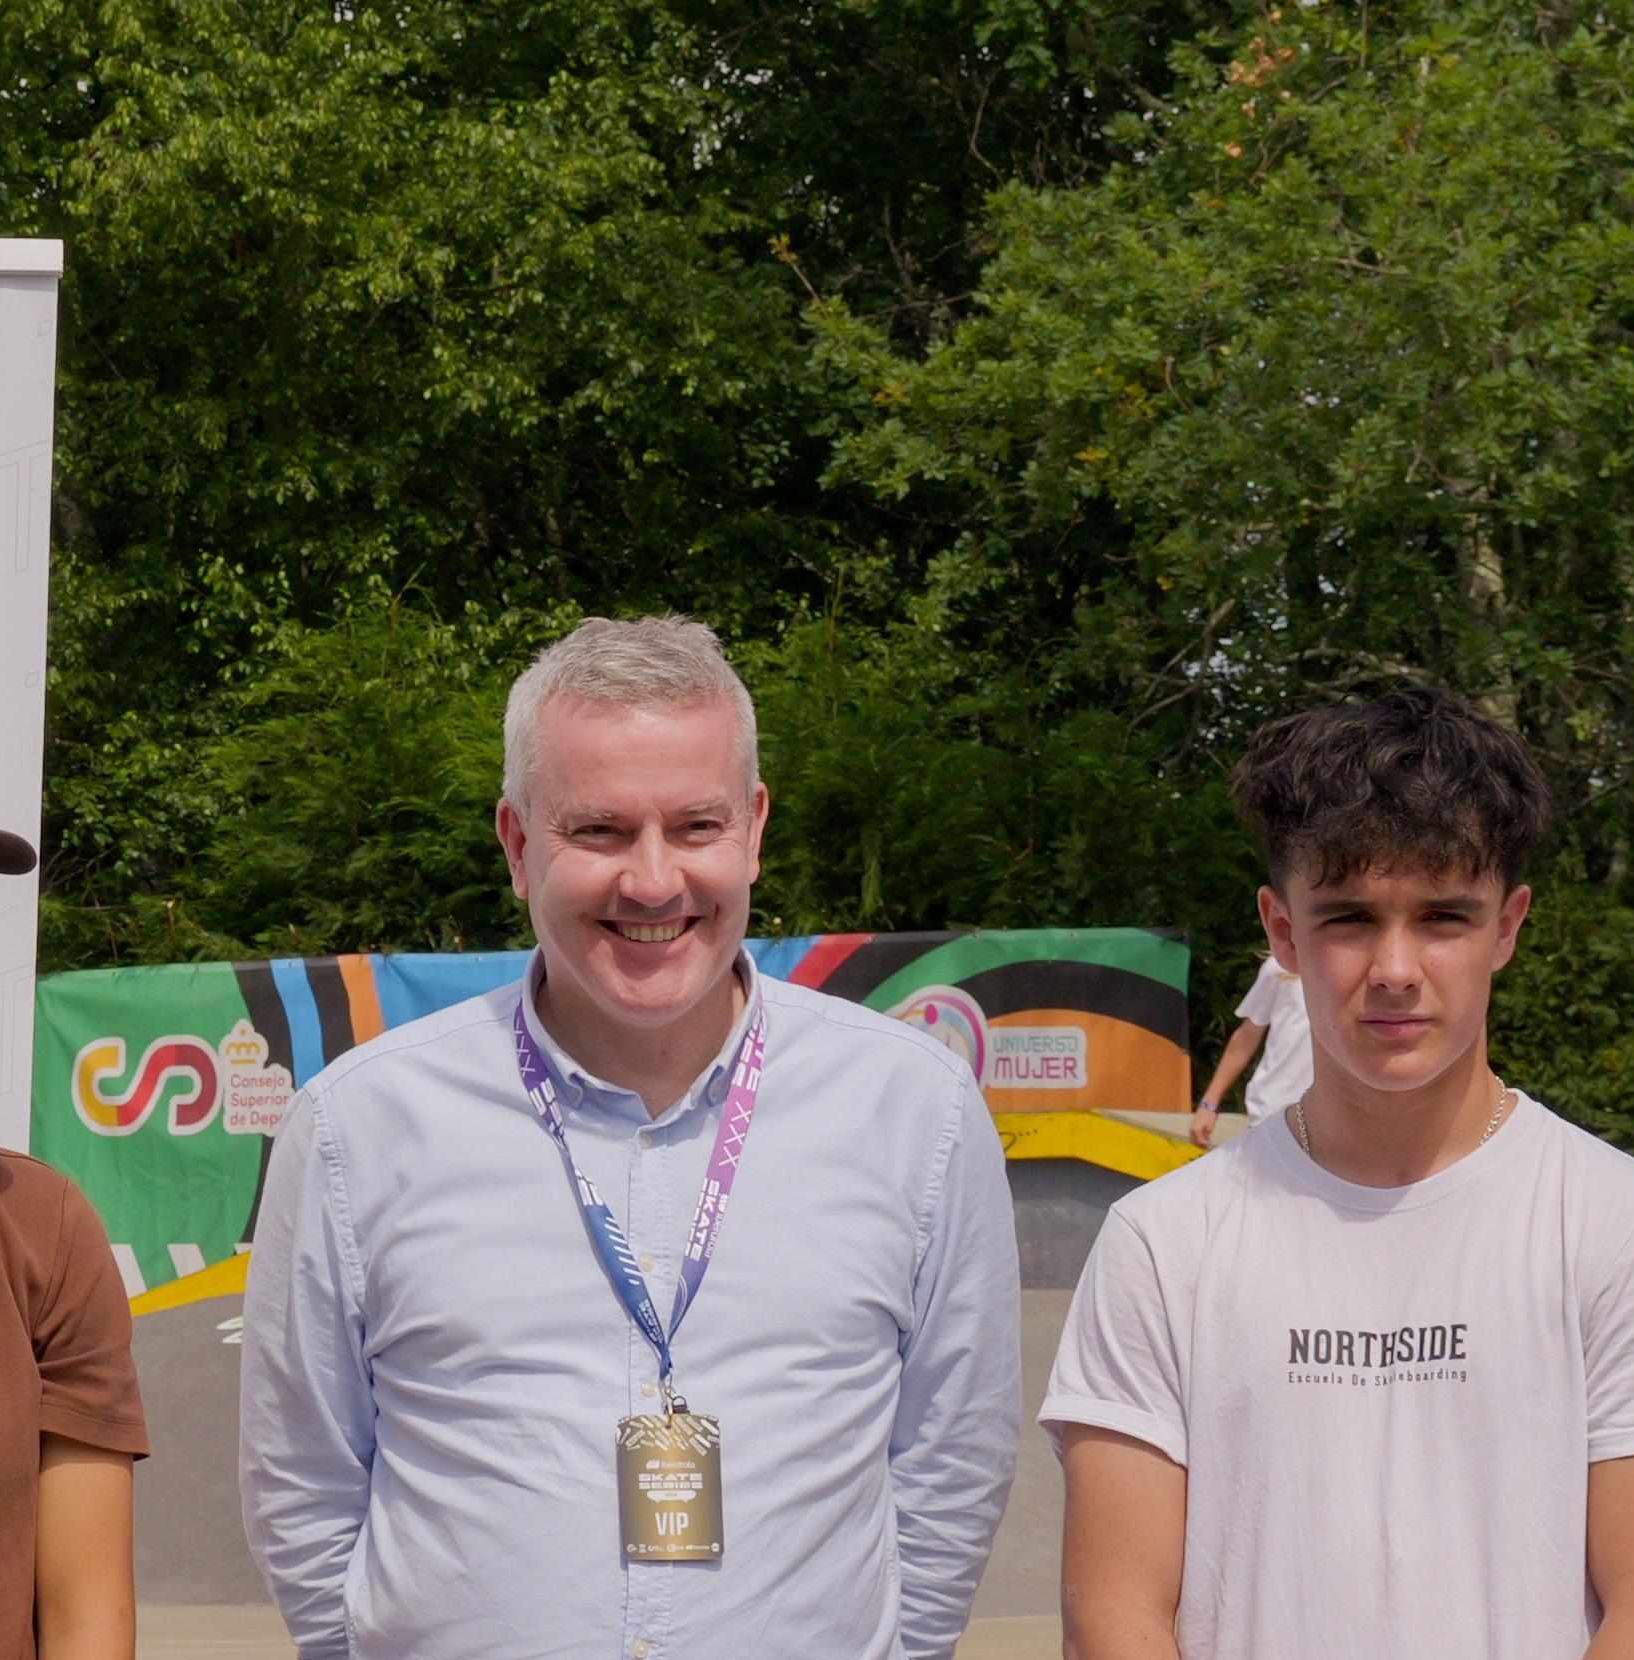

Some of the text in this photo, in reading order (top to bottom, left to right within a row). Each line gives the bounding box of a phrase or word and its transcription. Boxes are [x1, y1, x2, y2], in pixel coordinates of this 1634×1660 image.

[993, 1035, 1079, 1053] UNIVERSO
[994, 1056, 1078, 1079] MUJER
[230, 1074, 285, 1093] Consejo
[231, 1093, 288, 1110] Superior
[230, 1112, 246, 1126] de
[1288, 1324, 1468, 1367] NORTHSIDE
[1288, 1371, 1343, 1385] Escuela
[1352, 1373, 1366, 1387] De
[655, 1512, 689, 1537] VIP
